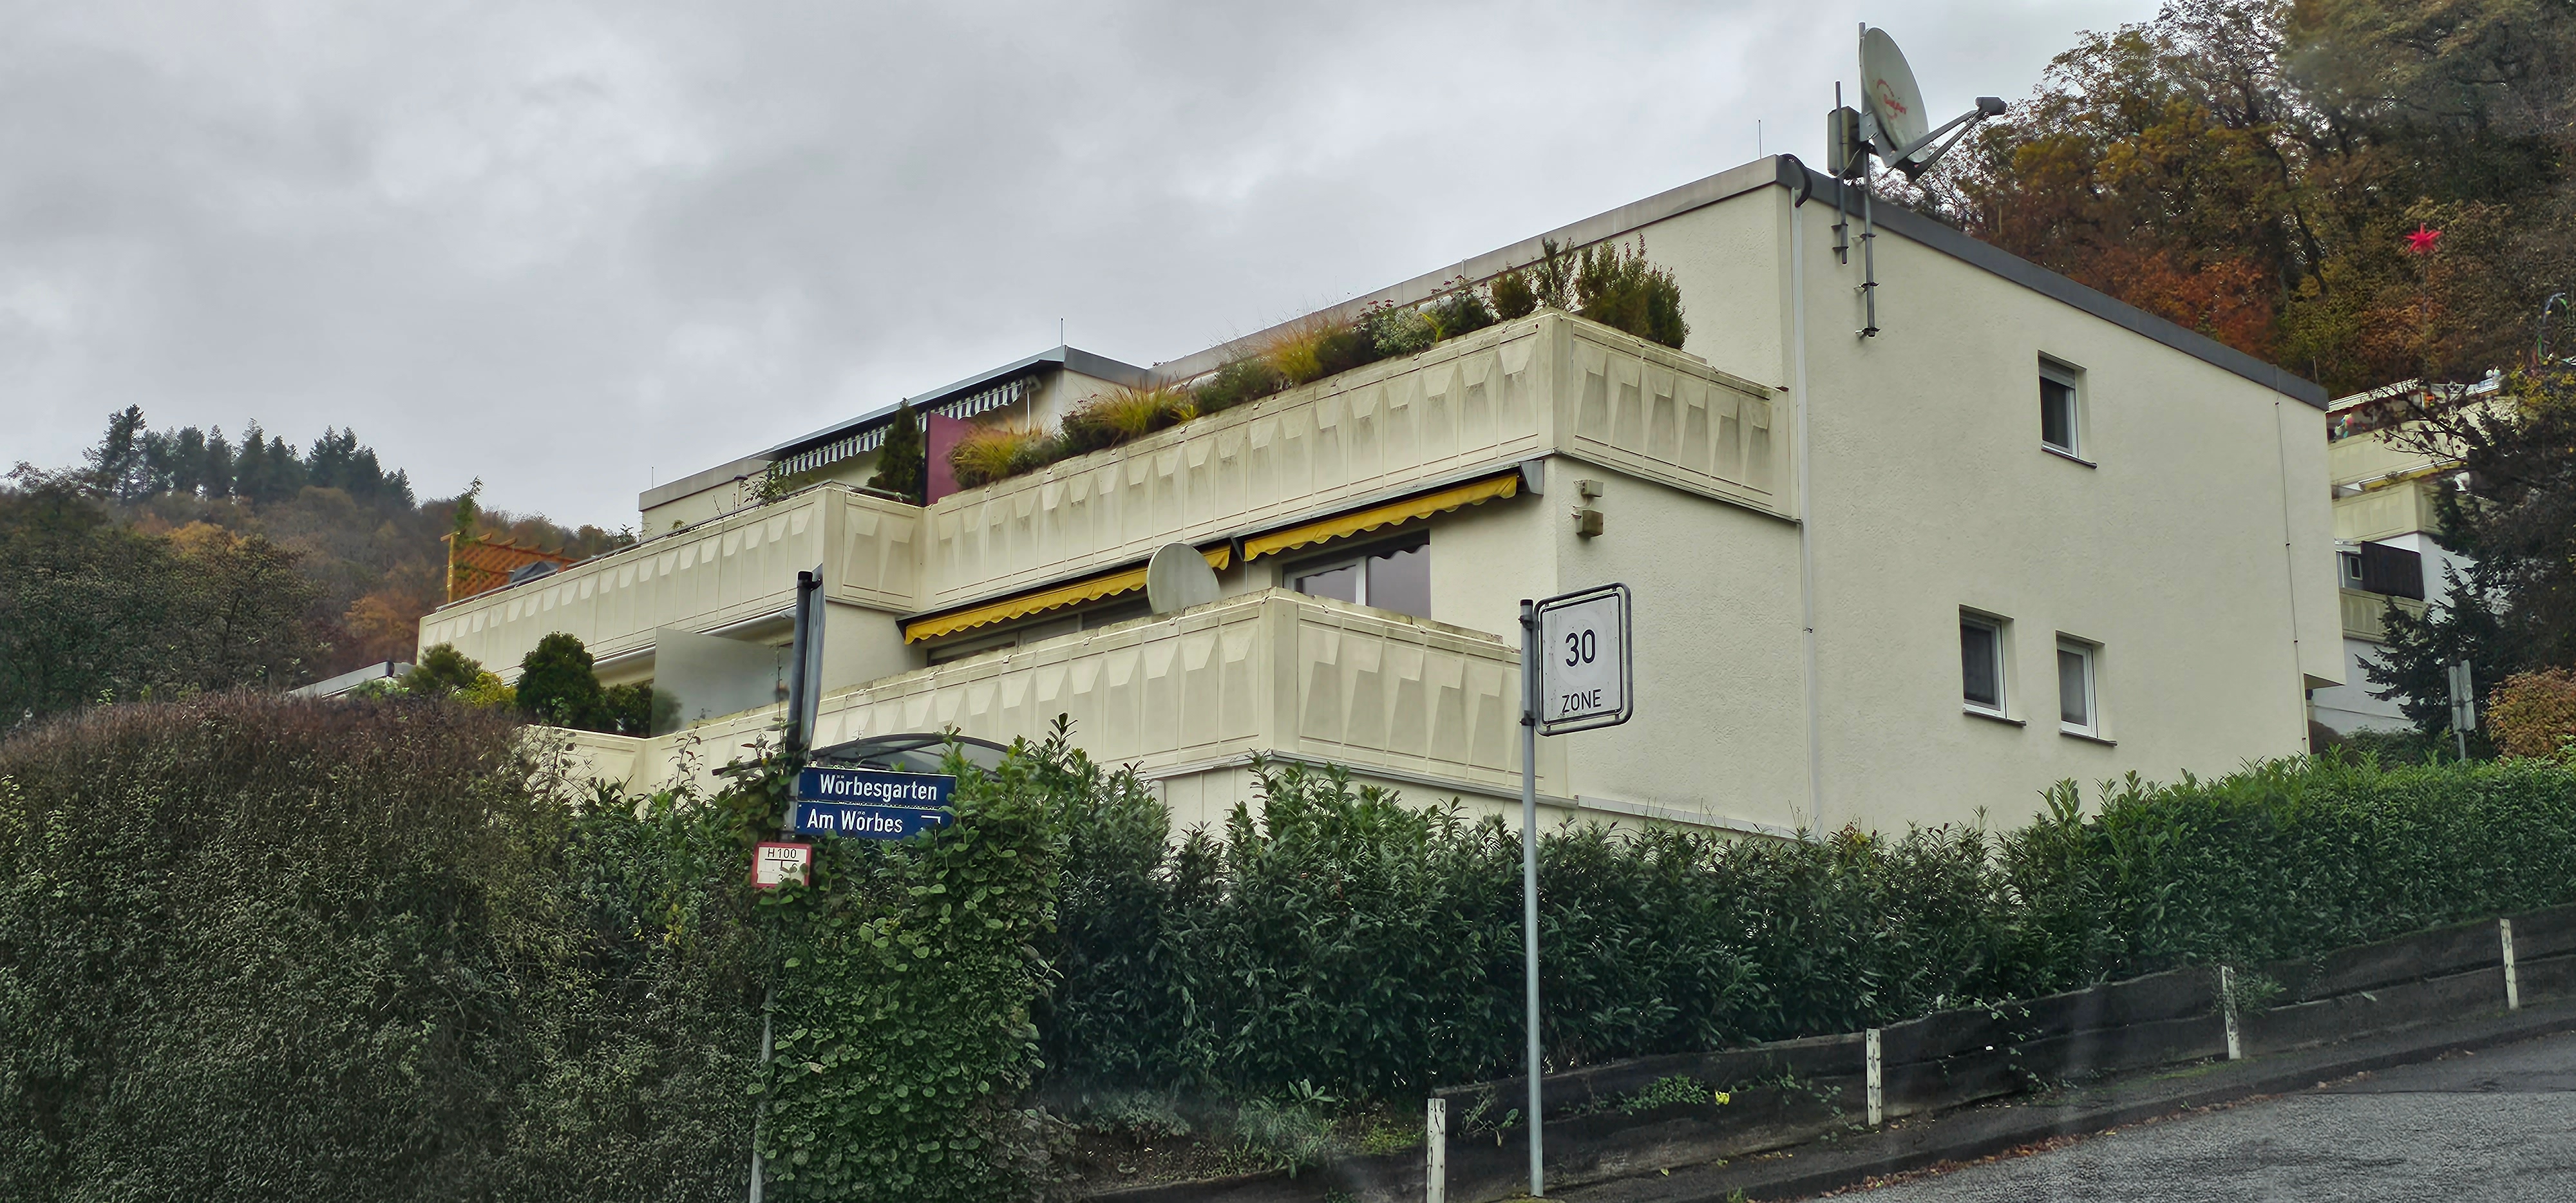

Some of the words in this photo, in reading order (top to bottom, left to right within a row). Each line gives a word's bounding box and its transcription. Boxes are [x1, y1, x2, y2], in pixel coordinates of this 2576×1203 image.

[1565, 629, 1596, 667] 30
[1562, 688, 1602, 714] ZONE
[820, 773, 938, 802] Wörbesgarten
[807, 808, 835, 829] Am
[841, 810, 904, 833] Wörbes
